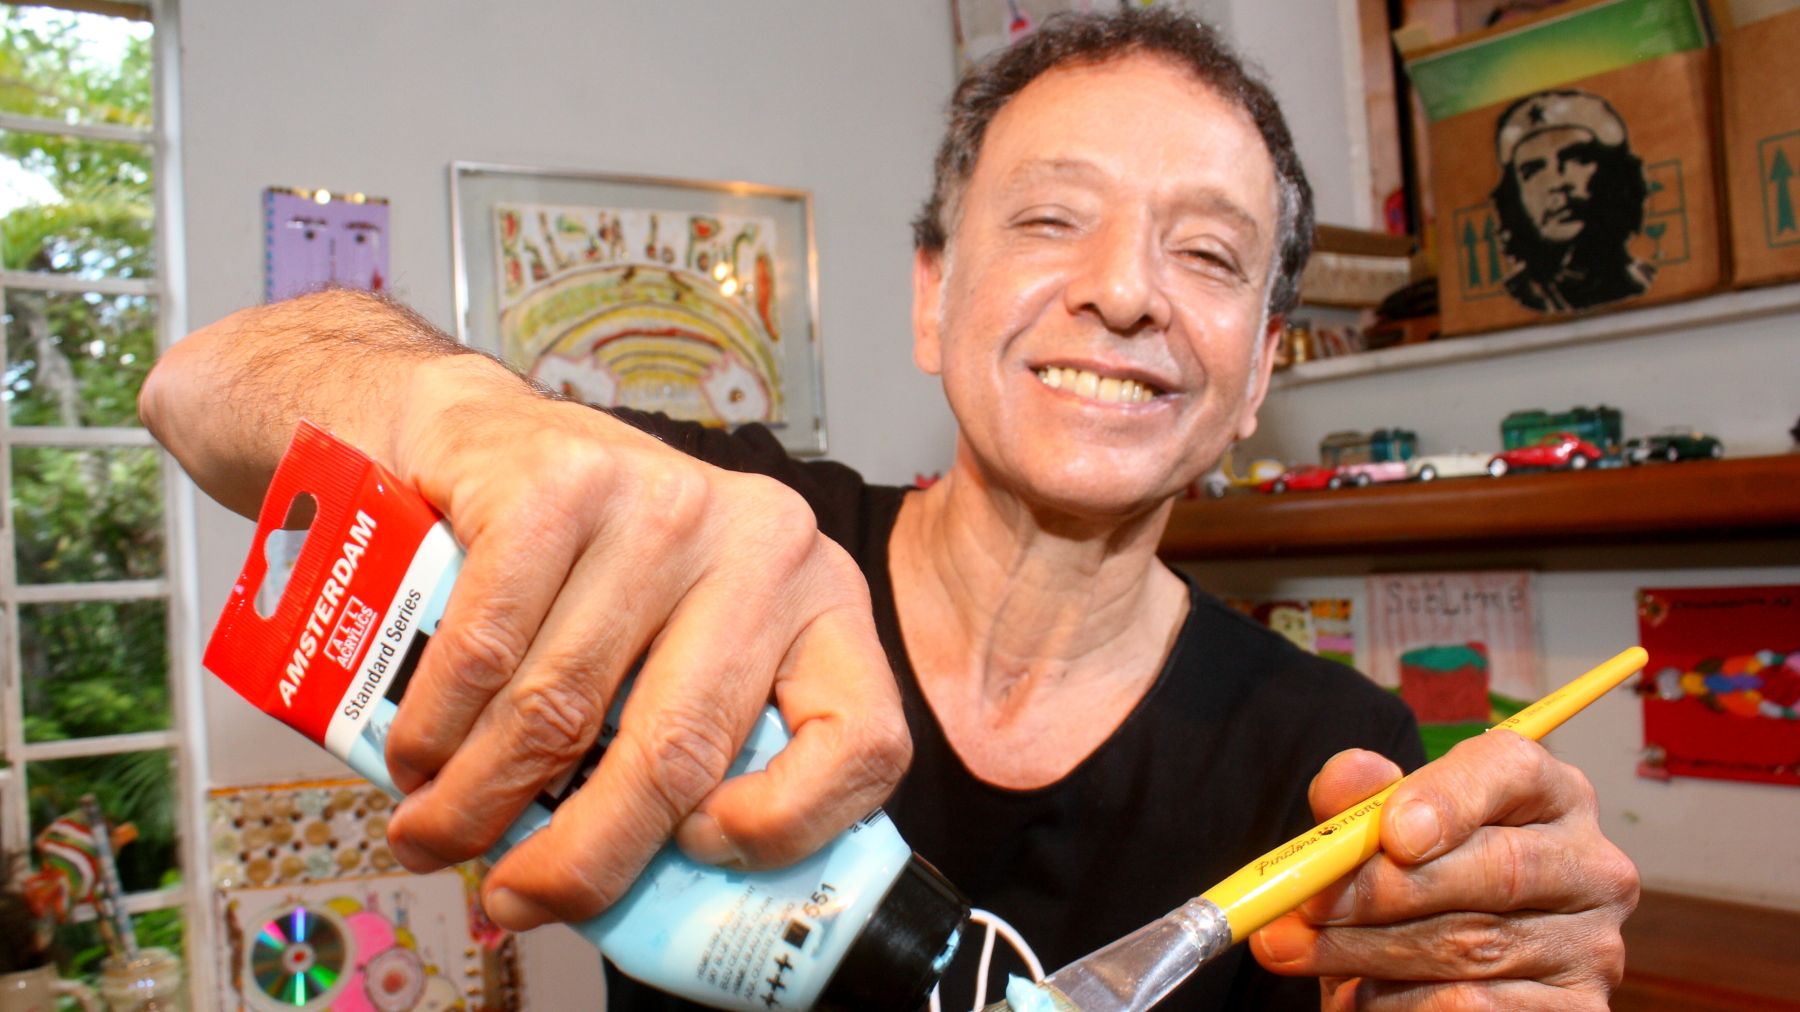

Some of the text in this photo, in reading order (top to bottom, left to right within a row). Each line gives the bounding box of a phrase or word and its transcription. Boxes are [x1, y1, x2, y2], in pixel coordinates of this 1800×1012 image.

[278, 510, 377, 708] AMSTERDAM
[337, 606, 373, 669] ACRYLICS
[343, 588, 422, 721] Standard Series
[1340, 799, 1382, 825] TIGRE
[803, 883, 836, 918] 551
